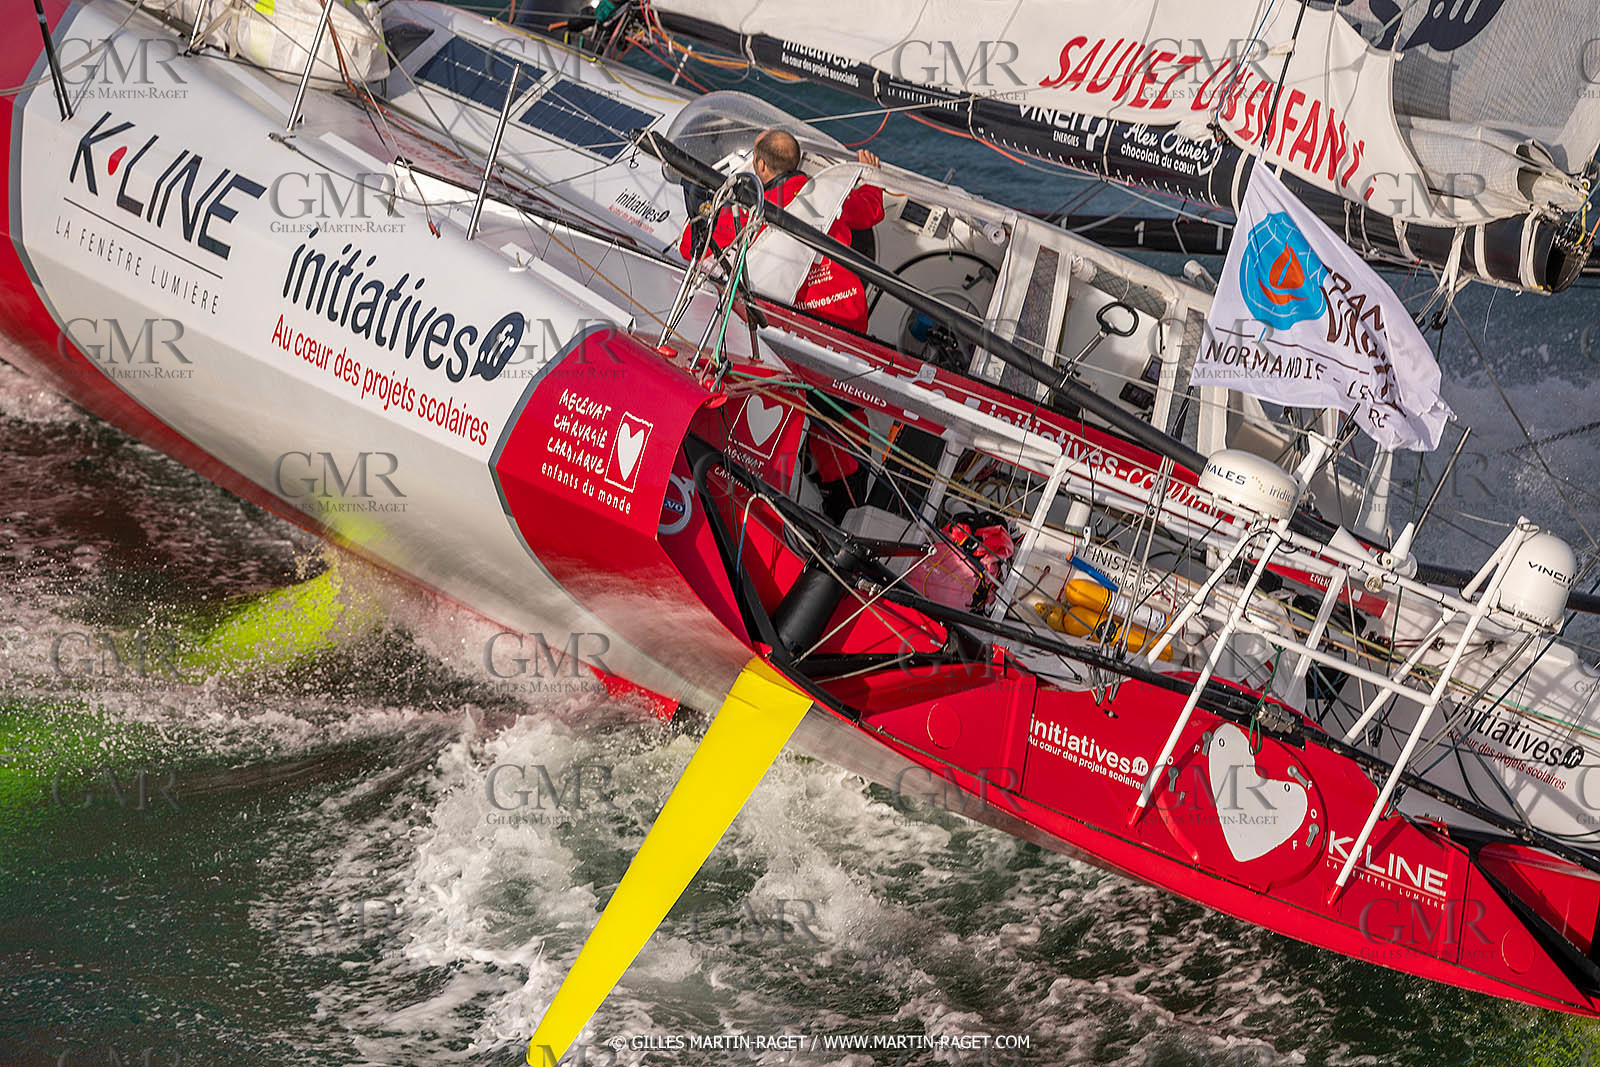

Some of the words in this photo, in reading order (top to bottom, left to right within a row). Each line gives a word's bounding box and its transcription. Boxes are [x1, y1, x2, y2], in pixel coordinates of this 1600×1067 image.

[1038, 35, 1203, 110] SAUVEZ
[1053, 130, 1080, 148] ENERGIES
[1122, 122, 1159, 147] Alex
[1120, 142, 1160, 166] chocolats
[1160, 153, 1172, 169] du
[1173, 161, 1197, 176] cœur
[55, 215, 71, 239] LA
[271, 313, 293, 351] Au
[294, 332, 333, 371] cœur
[334, 346, 361, 387] des
[361, 365, 416, 411] projets
[417, 395, 489, 446] scolaires
[832, 378, 888, 408] ENERGIES
[541, 462, 579, 490] enfants
[582, 478, 595, 497] du
[597, 489, 631, 515] monde
[1528, 560, 1568, 583] VINCI
[1039, 740, 1062, 756] cœur
[1062, 750, 1078, 763] des
[1078, 757, 1107, 775] projets
[1478, 742, 1496, 757] des
[1493, 752, 1527, 772] projets
[1525, 765, 1568, 791] scolaires
[1292, 840, 1298, 850] F
[1326, 860, 1338, 870] LA
